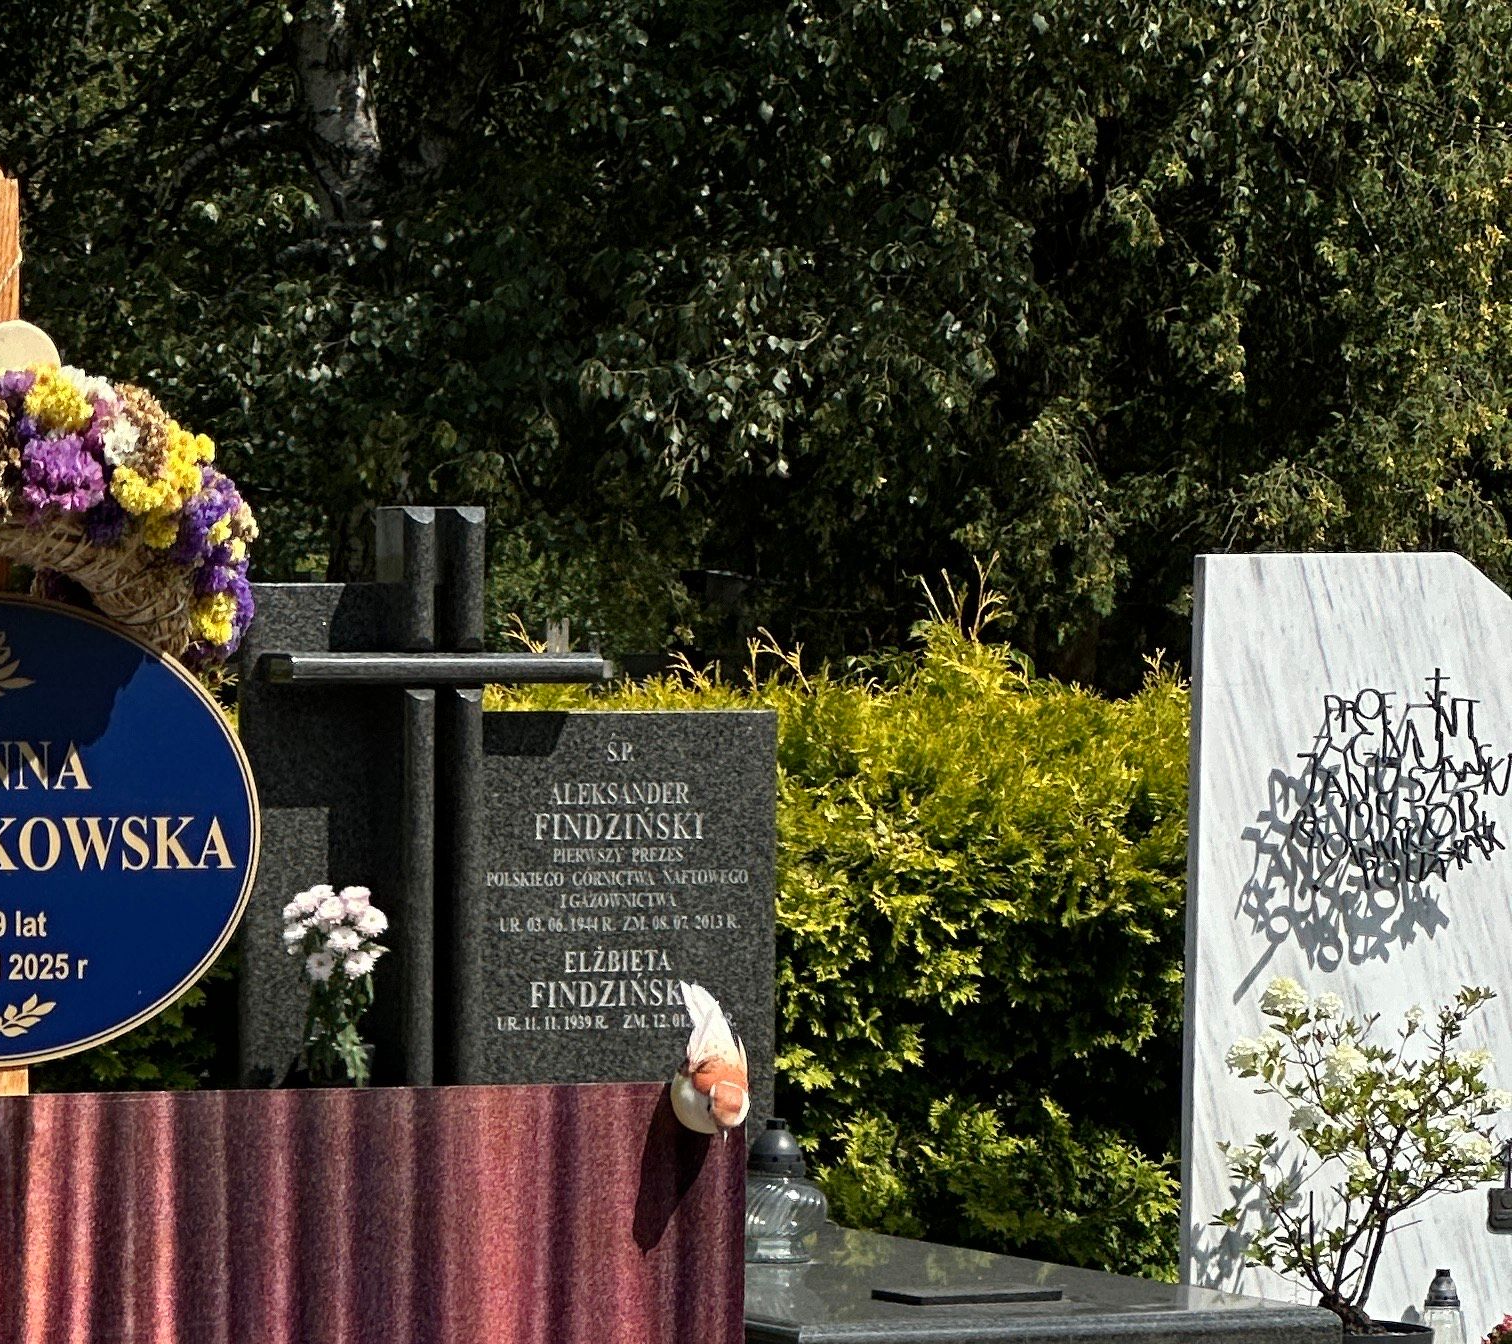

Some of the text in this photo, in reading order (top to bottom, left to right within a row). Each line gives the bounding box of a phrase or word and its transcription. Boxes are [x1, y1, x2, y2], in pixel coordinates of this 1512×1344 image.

[548, 782, 690, 805] ALEKSANDER
[534, 807, 705, 841] FINDZIŃSKI
[553, 847, 685, 863] PIERWSZY PREZES
[487, 871, 565, 887] POLSKIEGO
[662, 869, 749, 885] NAFTOWEGO
[15, 911, 47, 937] lat
[8, 953, 69, 980] 2025
[76, 959, 88, 979] r
[564, 945, 673, 973] ELŻBIETA
[530, 973, 692, 1009] FINDZIŃSK
[564, 1015, 591, 1030] 1939
